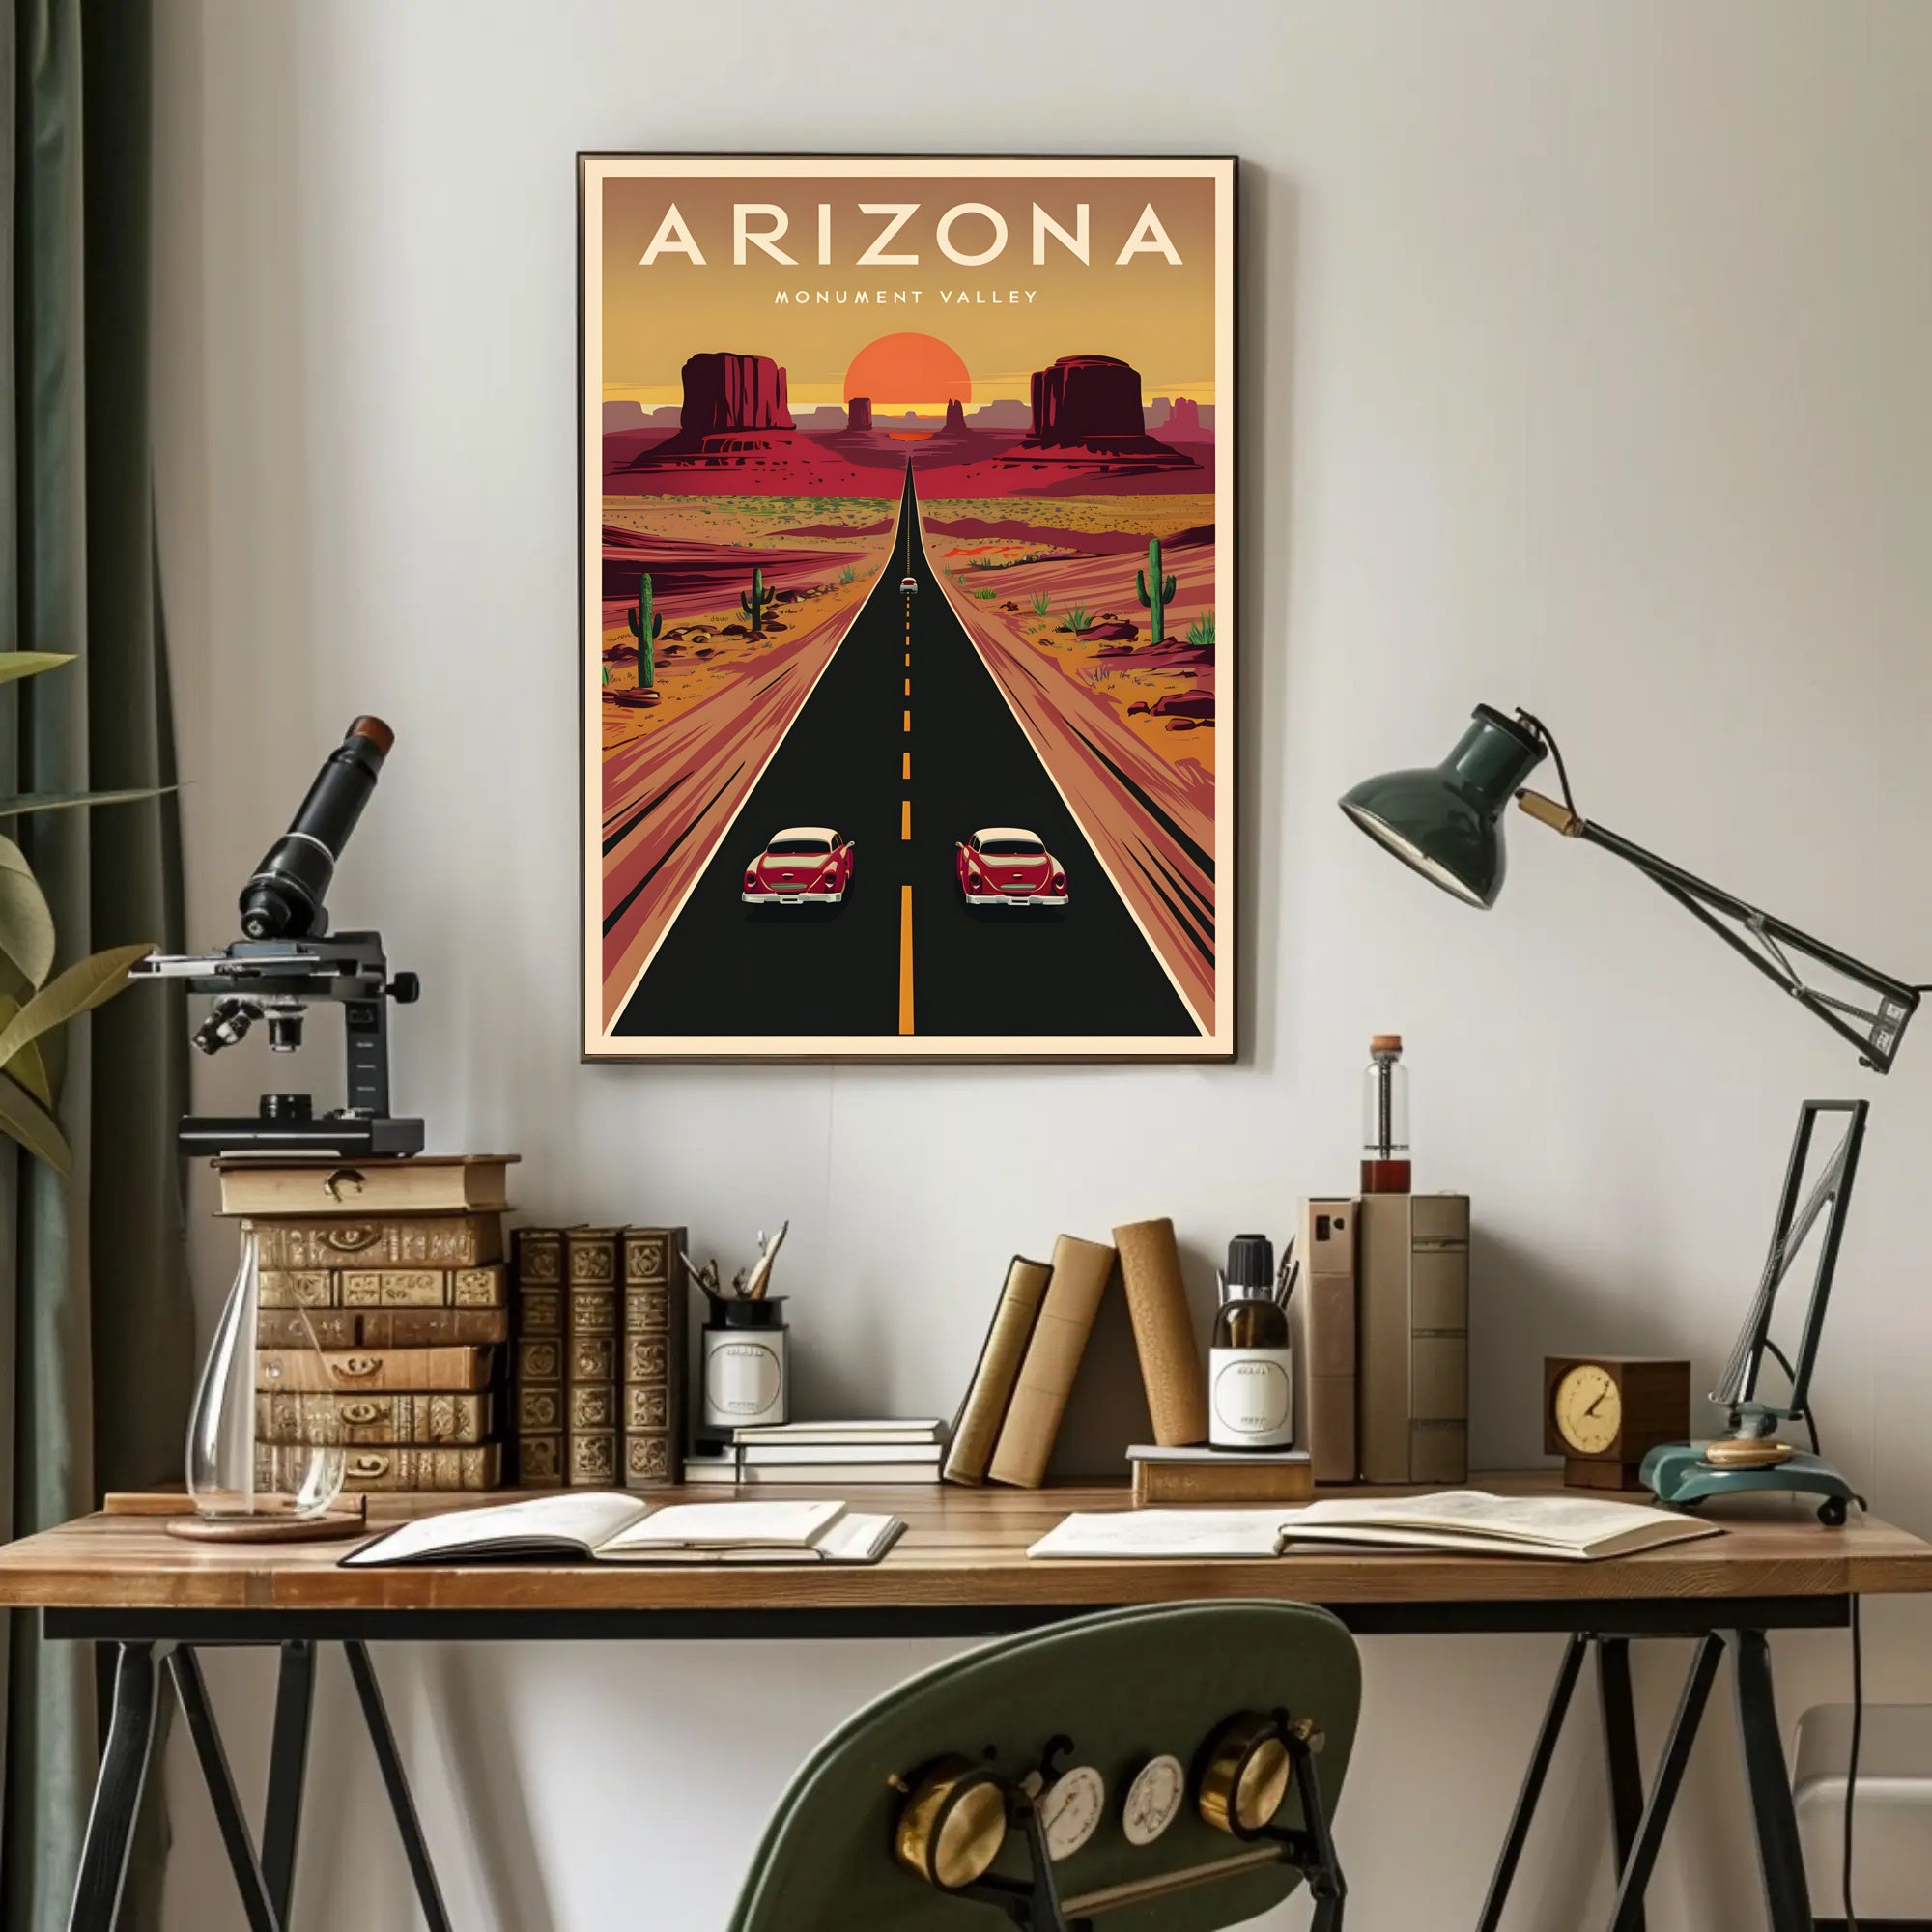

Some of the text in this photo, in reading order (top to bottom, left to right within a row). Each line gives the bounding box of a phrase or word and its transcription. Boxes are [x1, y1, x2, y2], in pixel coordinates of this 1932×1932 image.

[639, 201, 1183, 267] ARIZONA
[774, 290, 1038, 304] MONUMENT VALLEY
